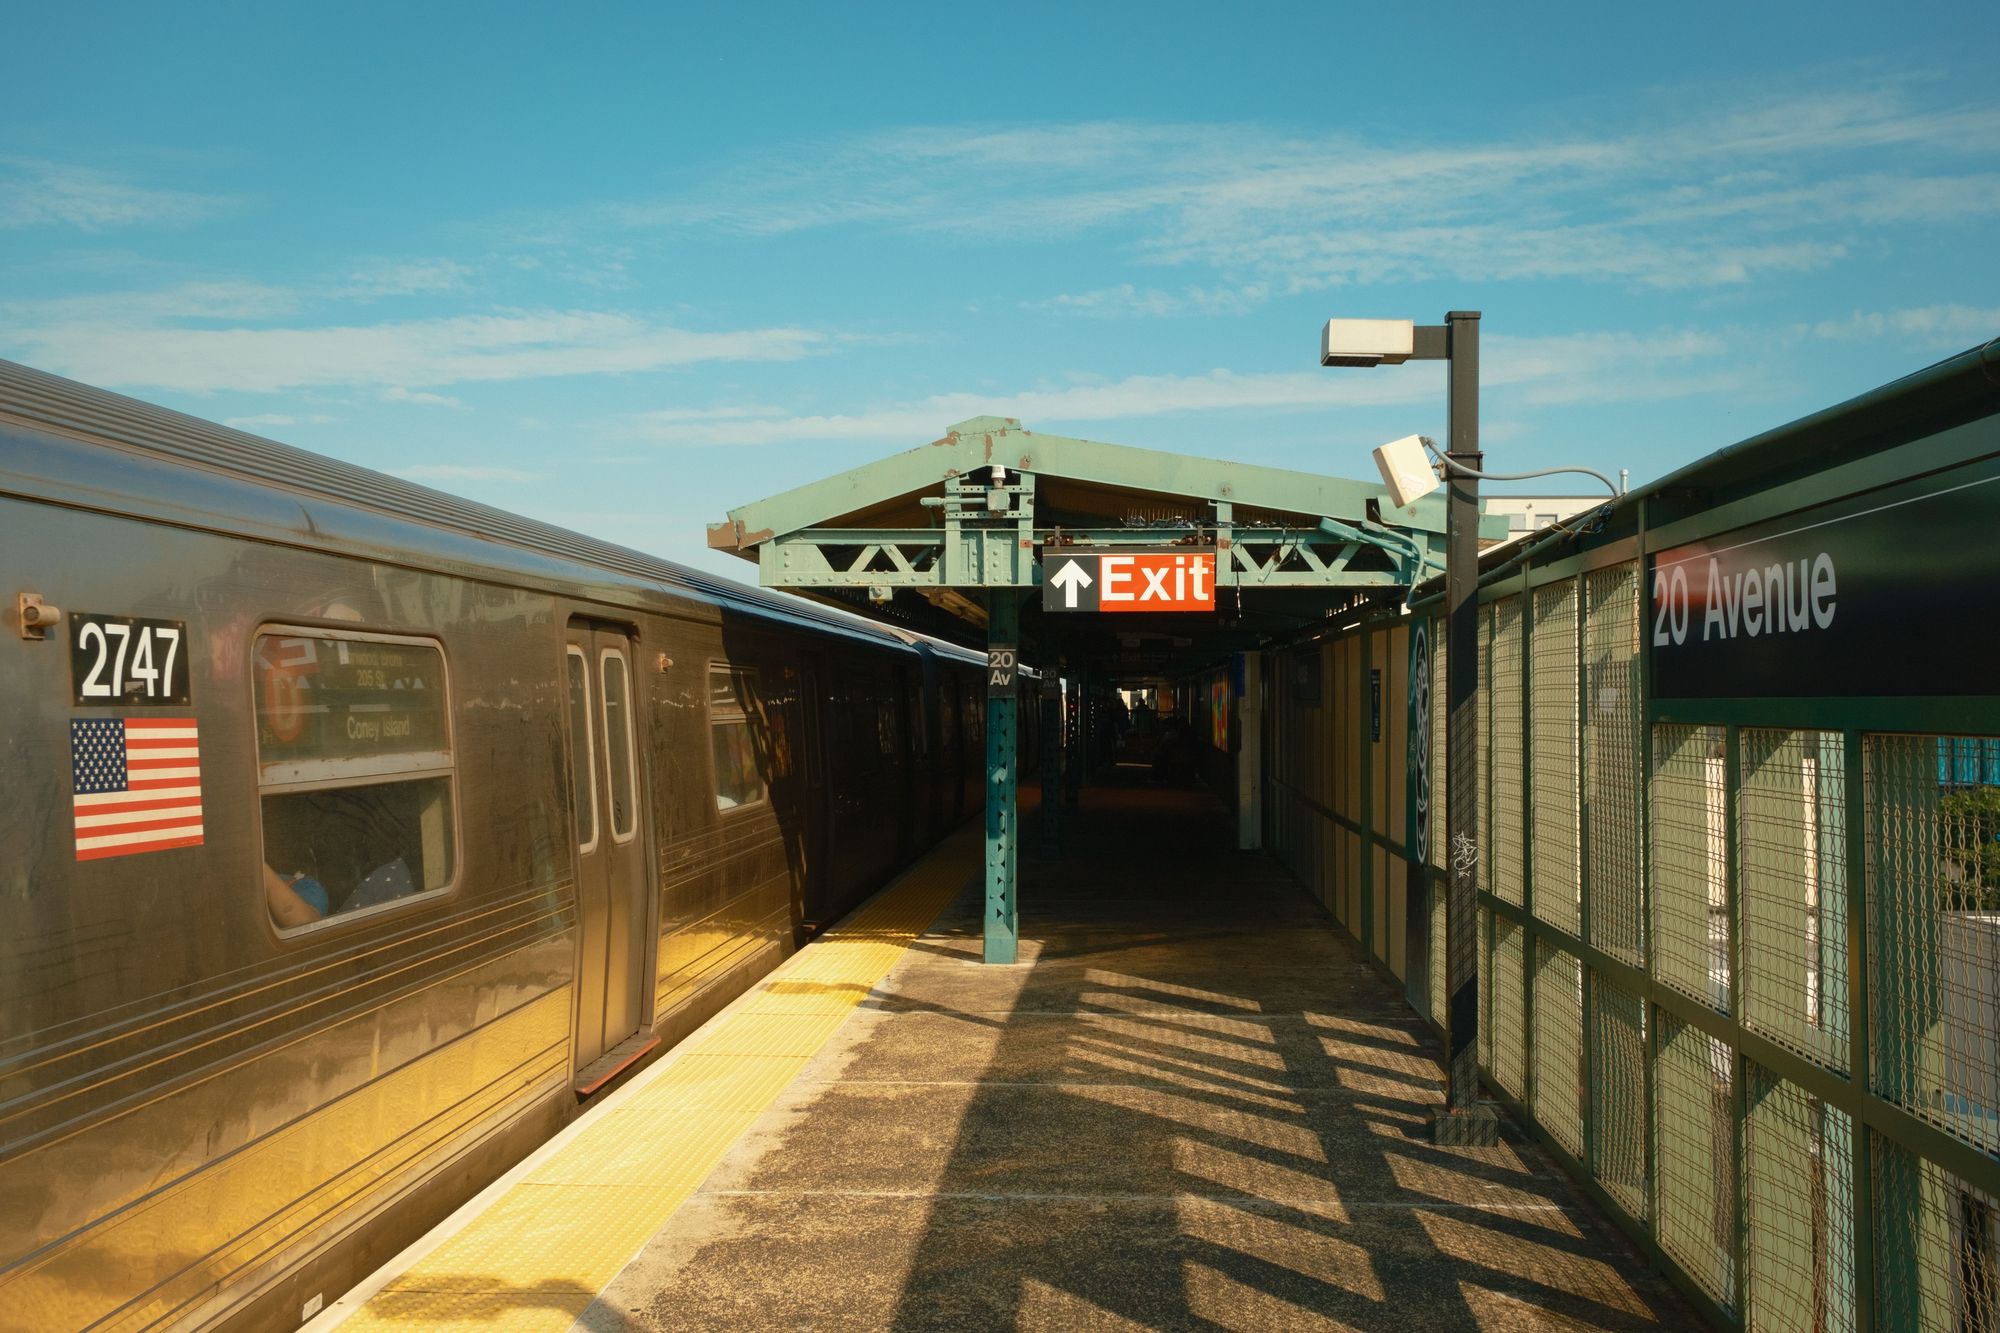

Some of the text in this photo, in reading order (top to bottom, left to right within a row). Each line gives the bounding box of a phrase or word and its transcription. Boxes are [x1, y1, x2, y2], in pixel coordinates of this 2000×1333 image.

[1101, 555, 1209, 601] Exit
[1653, 552, 1837, 648] 20 Avenue
[79, 622, 180, 698] 2747
[990, 651, 1014, 668] 20
[356, 669, 374, 687] 205
[990, 669, 1011, 686] Av
[1043, 669, 1057, 679] 20
[1043, 679, 1056, 689] Av
[346, 714, 410, 742] Coney Island
